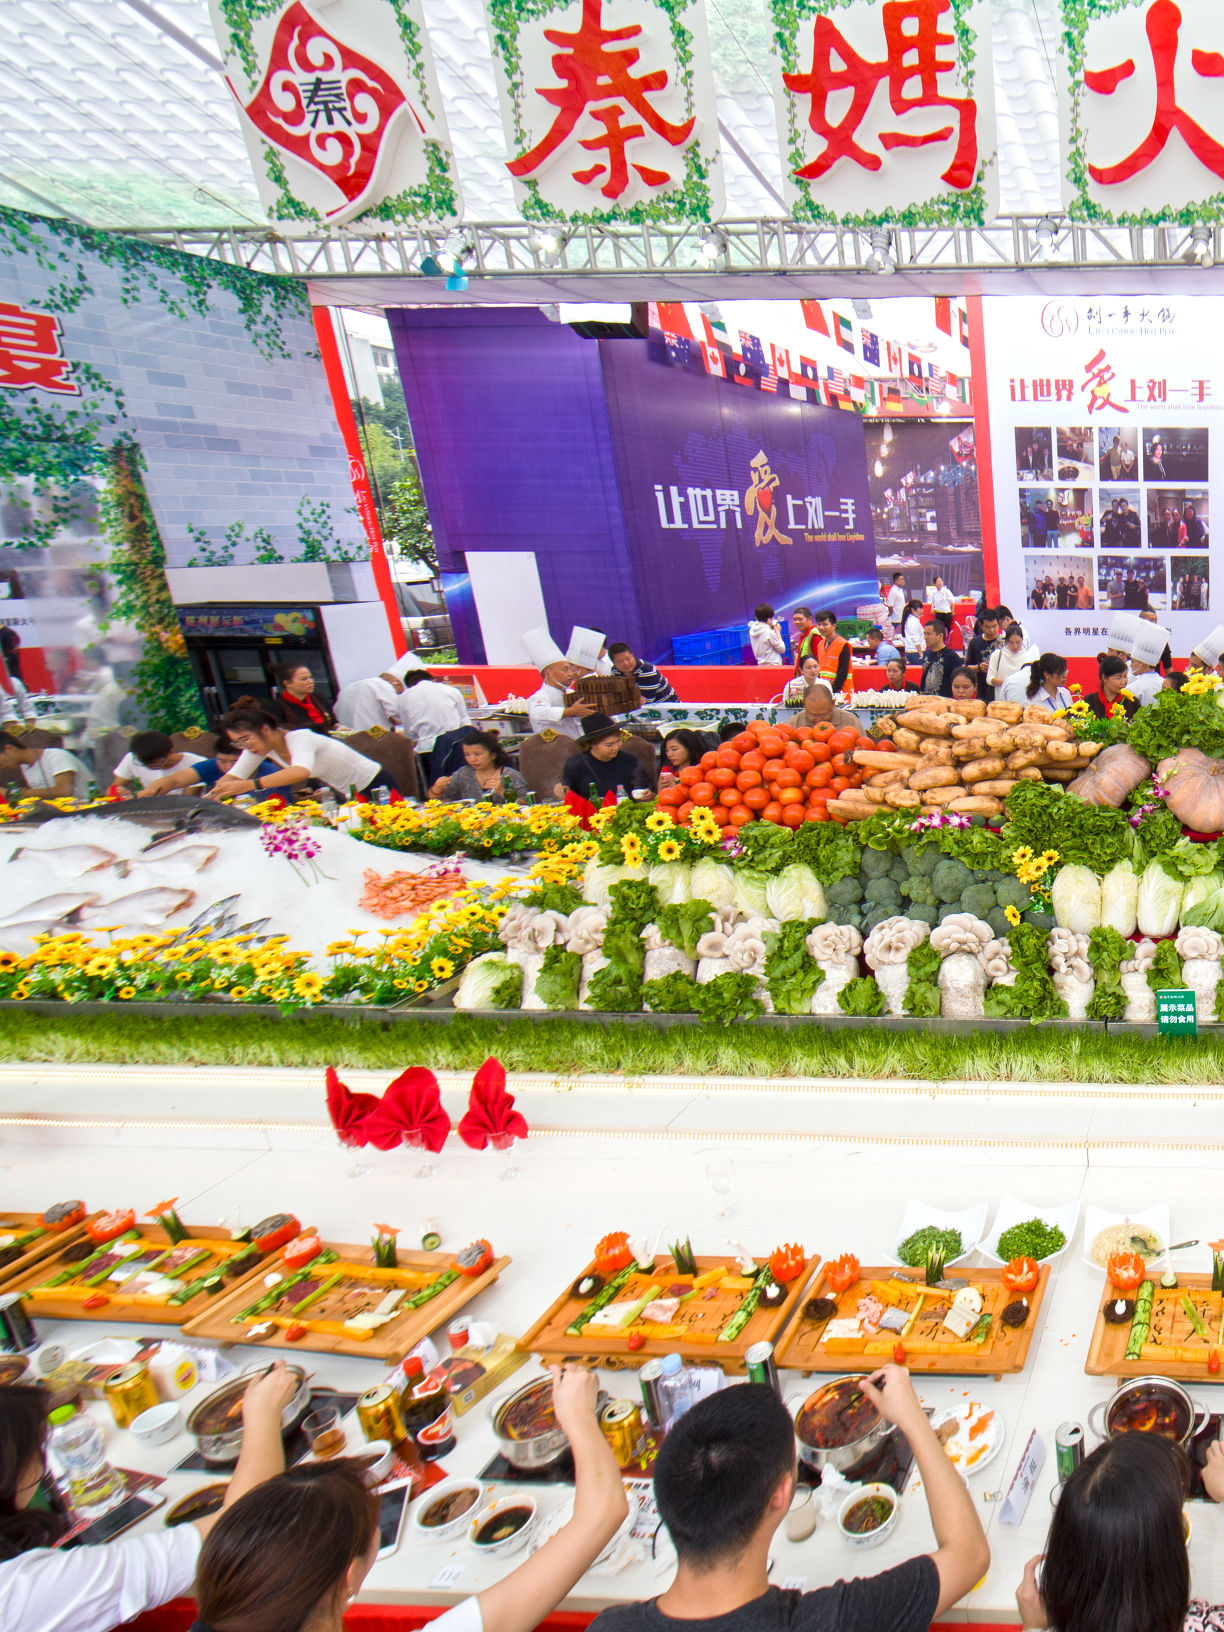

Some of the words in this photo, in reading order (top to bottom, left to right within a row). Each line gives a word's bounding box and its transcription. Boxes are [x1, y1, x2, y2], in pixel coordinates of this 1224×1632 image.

[299, 76, 353, 128] 秦
[1065, 627, 1109, 637] 各界明星在
[1160, 1004, 1194, 1012] 展示菜品
[1160, 1015, 1195, 1024] 请勿食用
